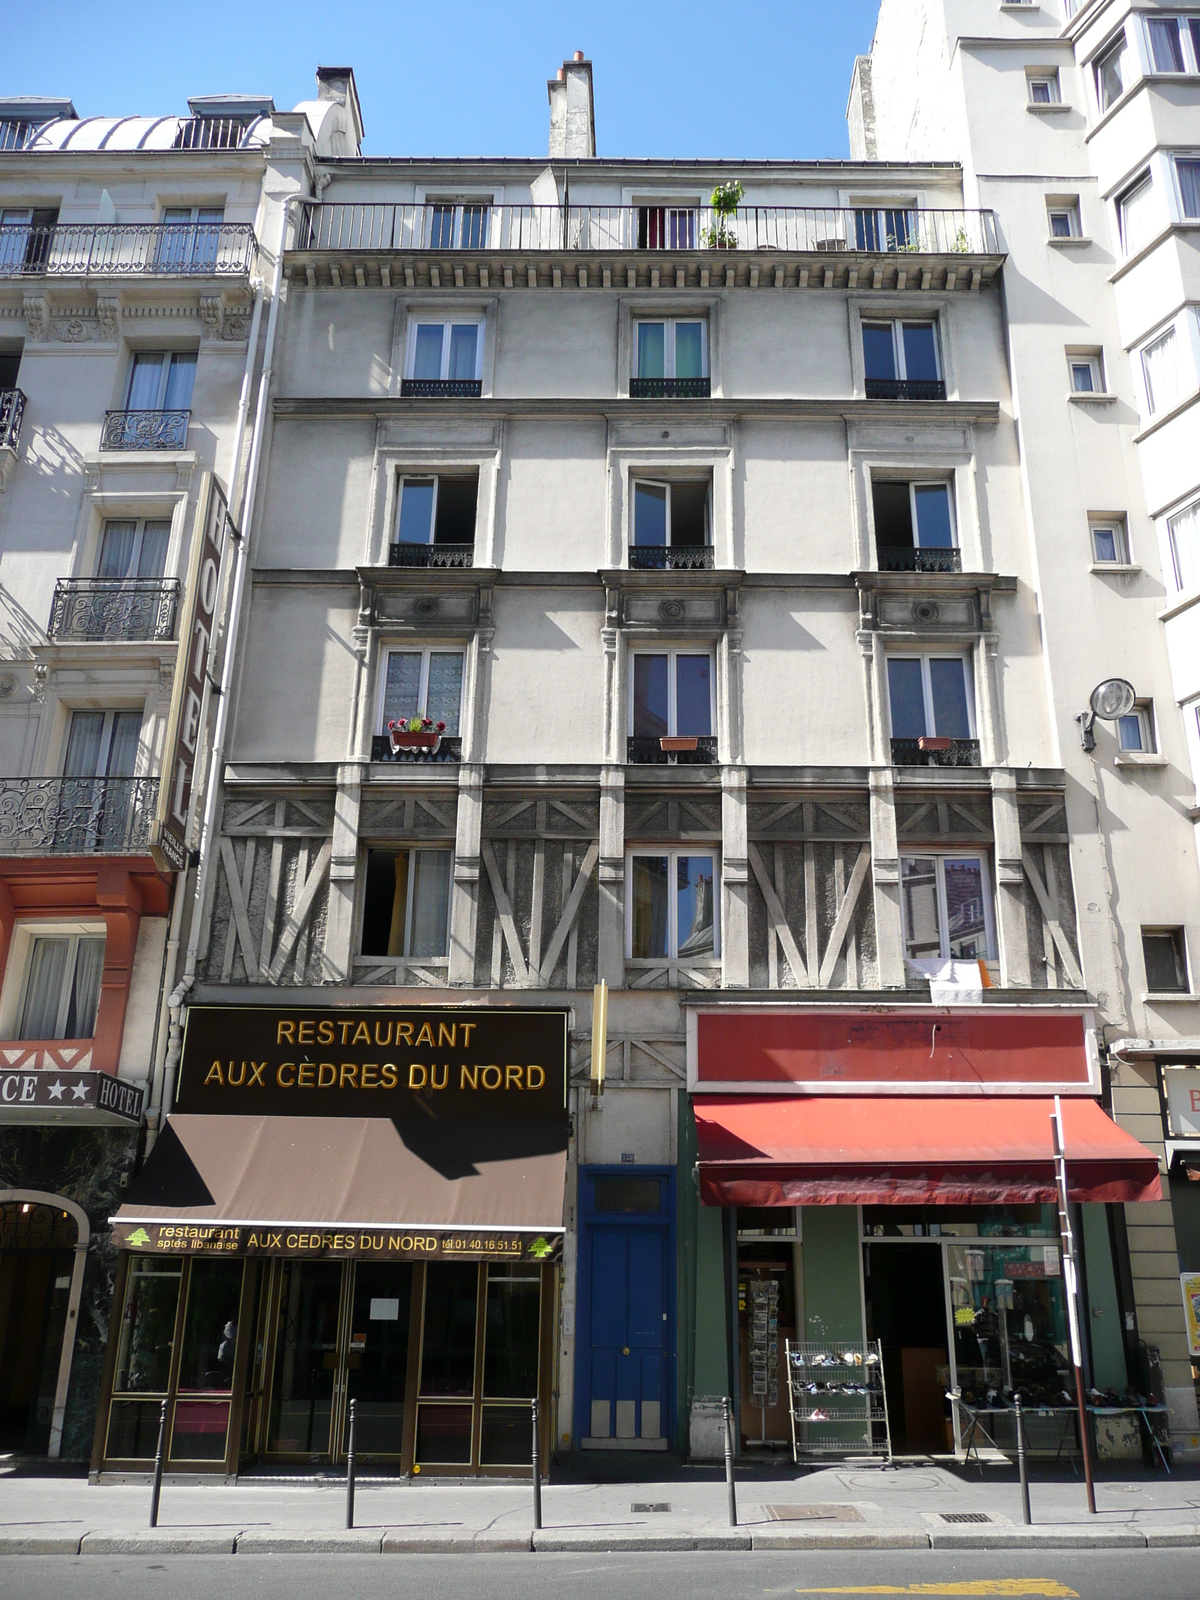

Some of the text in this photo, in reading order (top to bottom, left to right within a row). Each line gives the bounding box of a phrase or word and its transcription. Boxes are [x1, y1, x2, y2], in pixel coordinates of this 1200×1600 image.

[172, 486, 226, 827] HOTEL
[162, 838, 184, 869] FRANCE
[164, 827, 184, 856] VIEILLE
[276, 1019, 477, 1048] RESTAURANT
[203, 1055, 546, 1091] AUX CÈDRES DU NORD
[0, 1075, 38, 1102] CE
[100, 1078, 140, 1117] HOTEL
[159, 1226, 239, 1239] restaurant
[191, 1240, 238, 1250] libanaise
[247, 1233, 438, 1252] AUX CEDRES DU NORD
